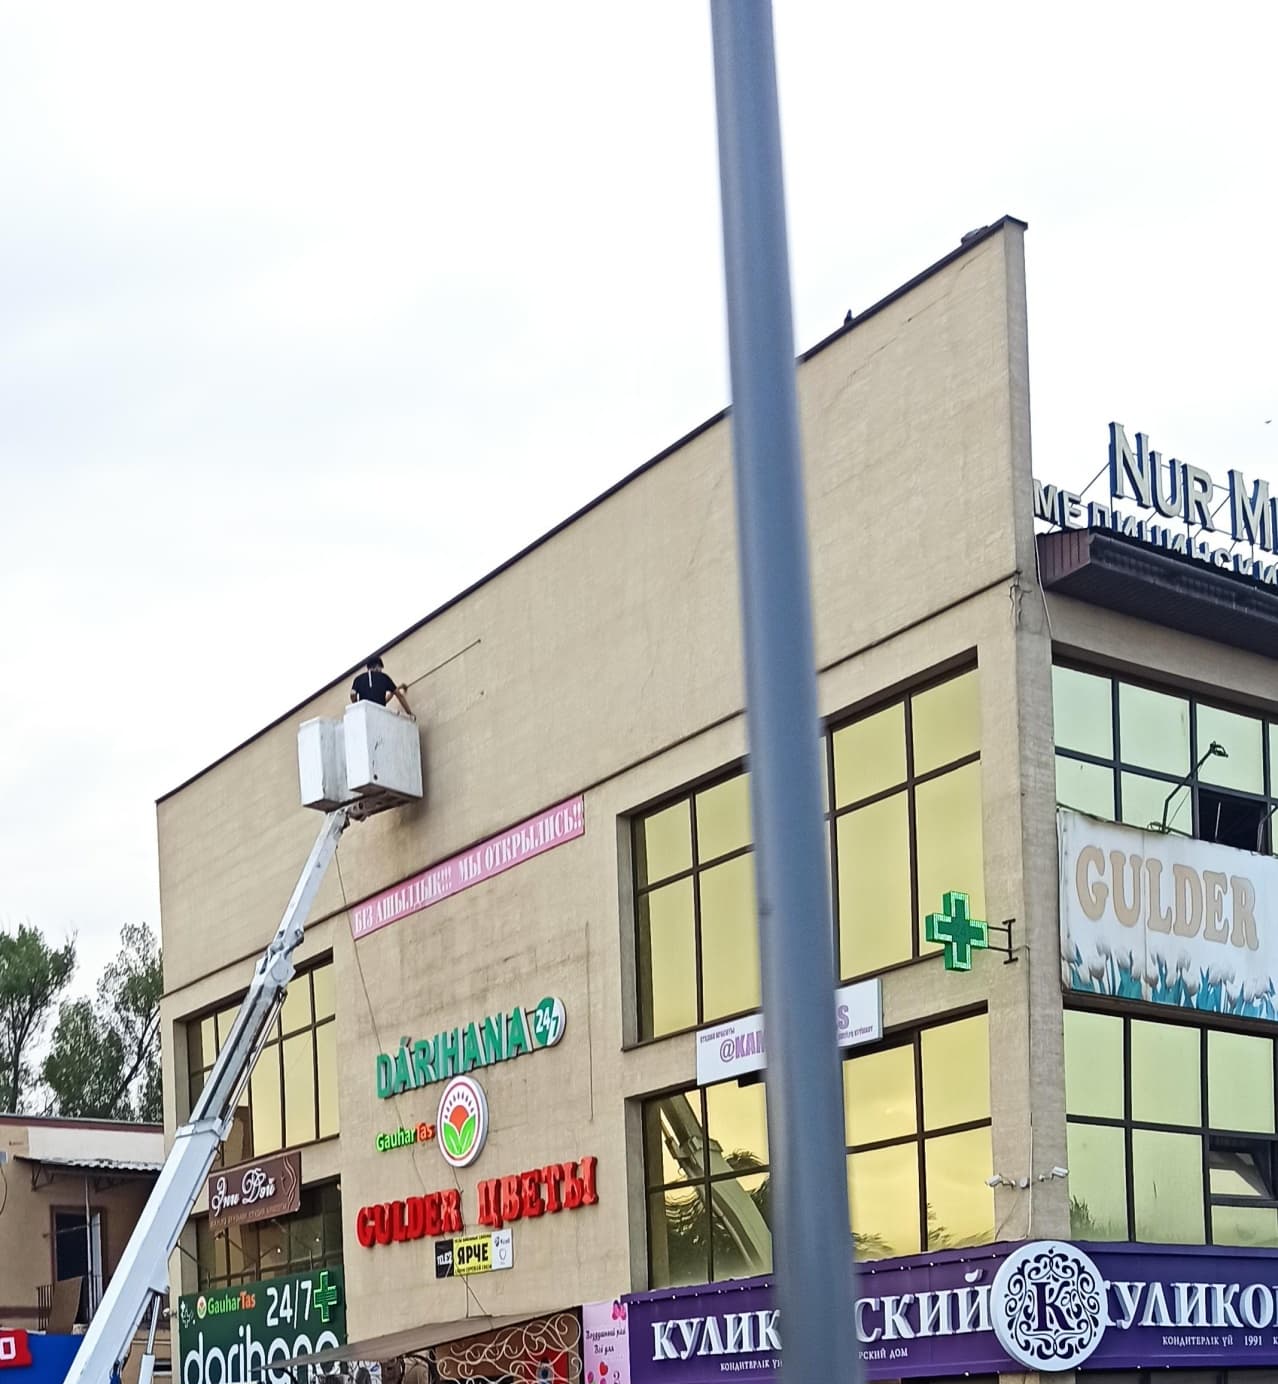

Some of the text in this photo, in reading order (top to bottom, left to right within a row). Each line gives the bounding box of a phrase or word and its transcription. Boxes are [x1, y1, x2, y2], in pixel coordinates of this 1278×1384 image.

[1109, 421, 1278, 557] NUR M
[459, 855, 482, 882] МЫ
[1076, 844, 1259, 951] GULDER
[376, 1123, 436, 1152] GauharTas
[356, 1188, 464, 1247] GULDER
[477, 1156, 598, 1228] ЦВЕТЫ
[457, 1243, 489, 1265] ЯРЧЕ
[208, 1291, 256, 1315] GauharTas
[266, 1280, 312, 1329] 24/7
[1103, 1280, 1278, 1330] УЛИКО
[889, 1347, 909, 1360] ДОМ
[1162, 1335, 1220, 1347] КОНДИТЕРЛІК
[1244, 1335, 1263, 1346] 1991
